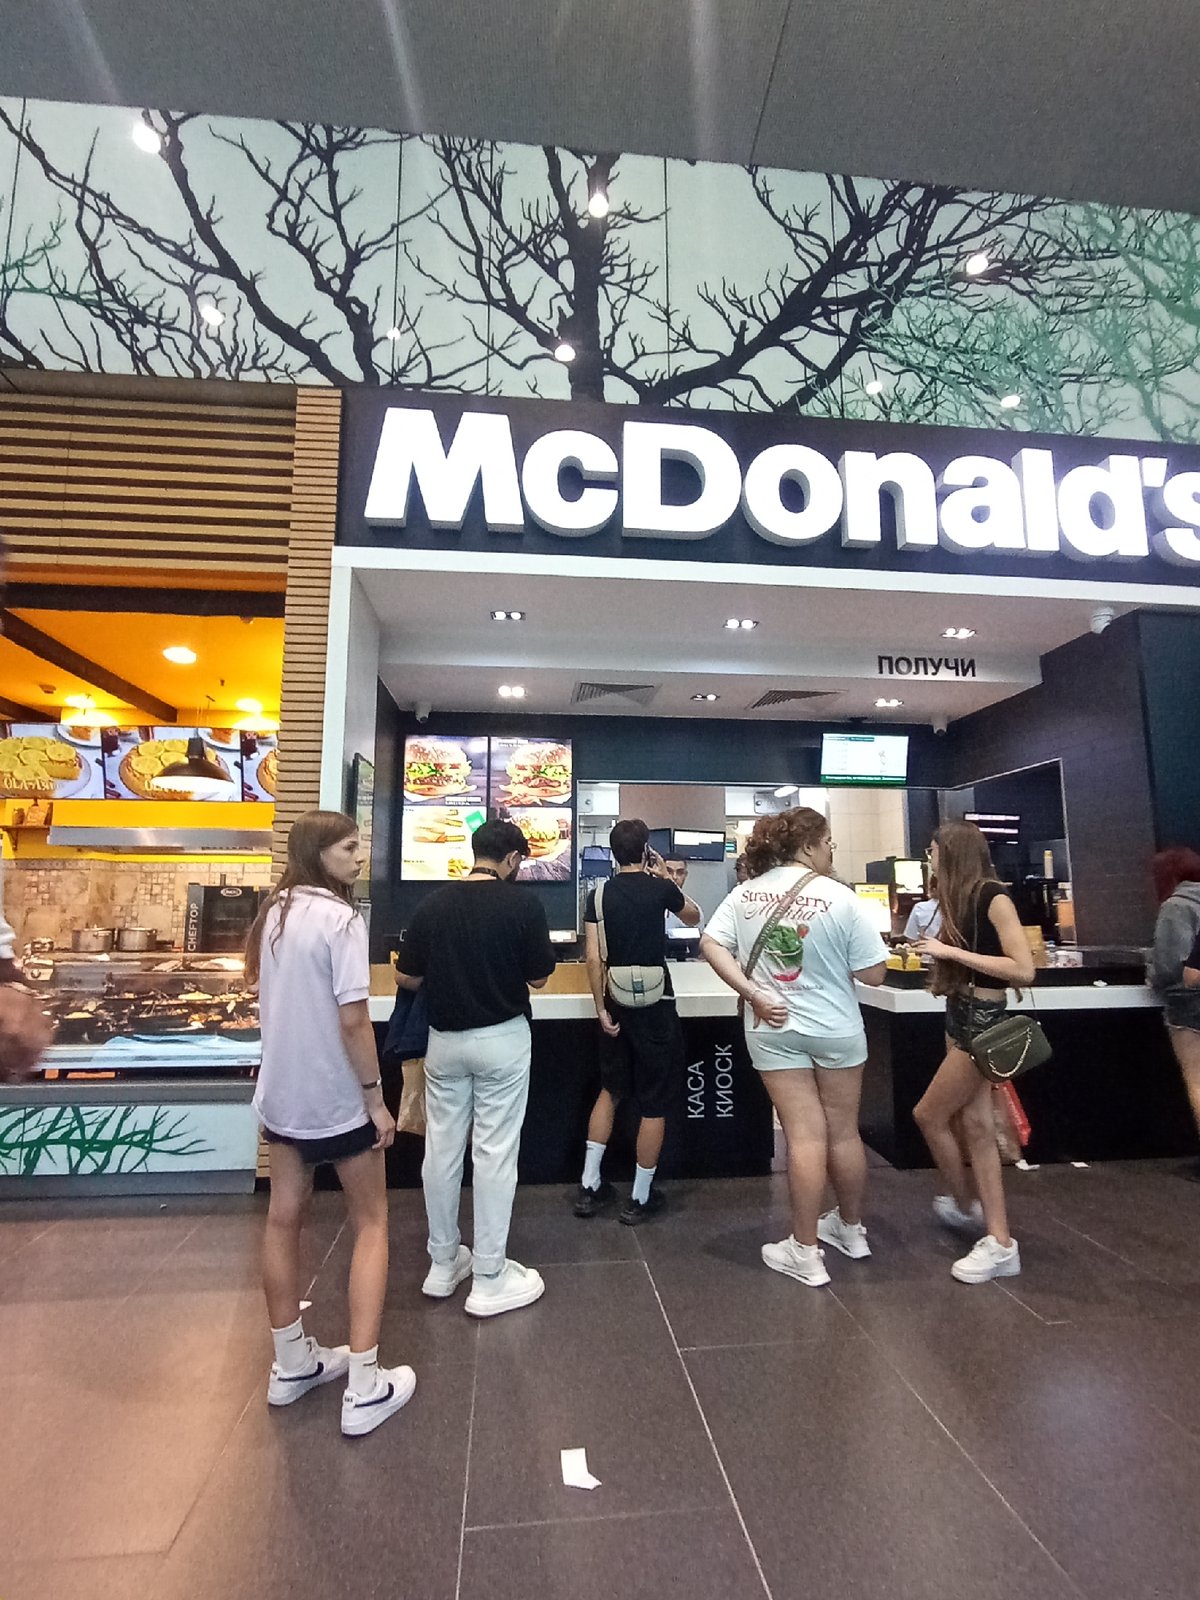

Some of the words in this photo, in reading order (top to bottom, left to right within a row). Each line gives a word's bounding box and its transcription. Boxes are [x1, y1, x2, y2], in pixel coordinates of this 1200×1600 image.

[364, 407, 1200, 563] McDonald's
[878, 655, 977, 678] ПОЛУЧИ
[187, 902, 199, 952] CHEFTOP
[741, 889, 832, 913] Strawerry
[687, 1060, 705, 1118] КАСА
[714, 1043, 734, 1118] КИОСК
